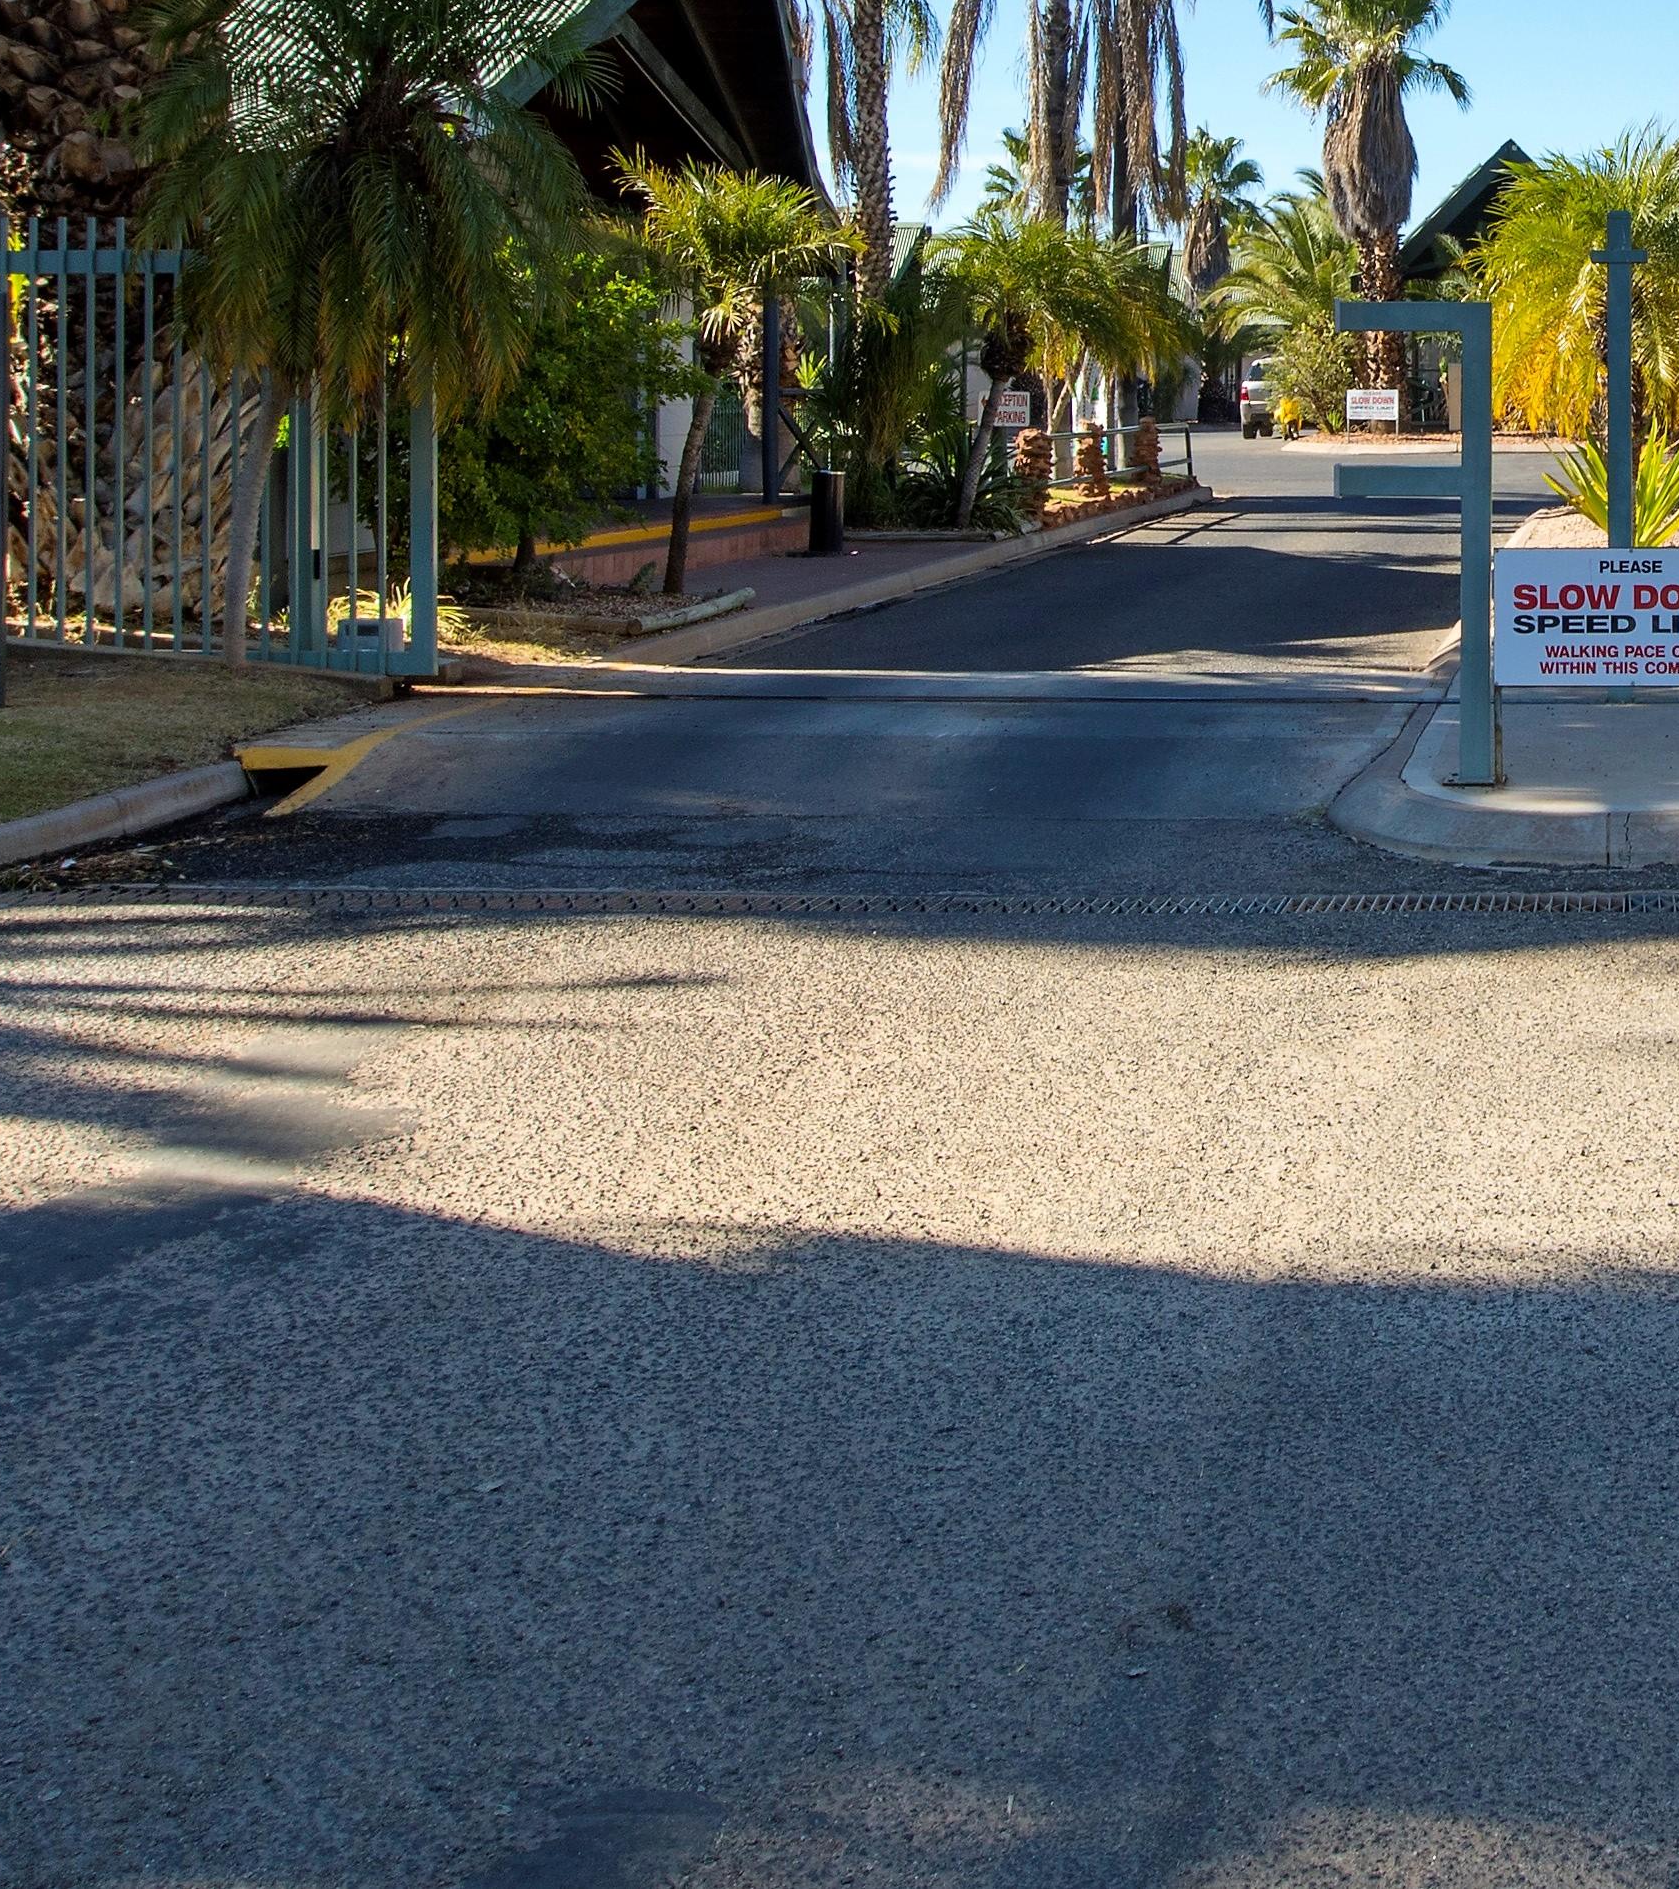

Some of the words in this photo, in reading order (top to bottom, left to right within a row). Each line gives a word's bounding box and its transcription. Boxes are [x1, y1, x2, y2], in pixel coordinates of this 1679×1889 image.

[1599, 560, 1663, 574] PLEASE
[1513, 584, 1621, 610] SLOW
[1513, 615, 1637, 634] SPEED
[1545, 645, 1619, 658] WALKING
[1625, 645, 1665, 658] PACE
[1539, 662, 1597, 675] WITHIN
[1602, 662, 1639, 675] THIS
